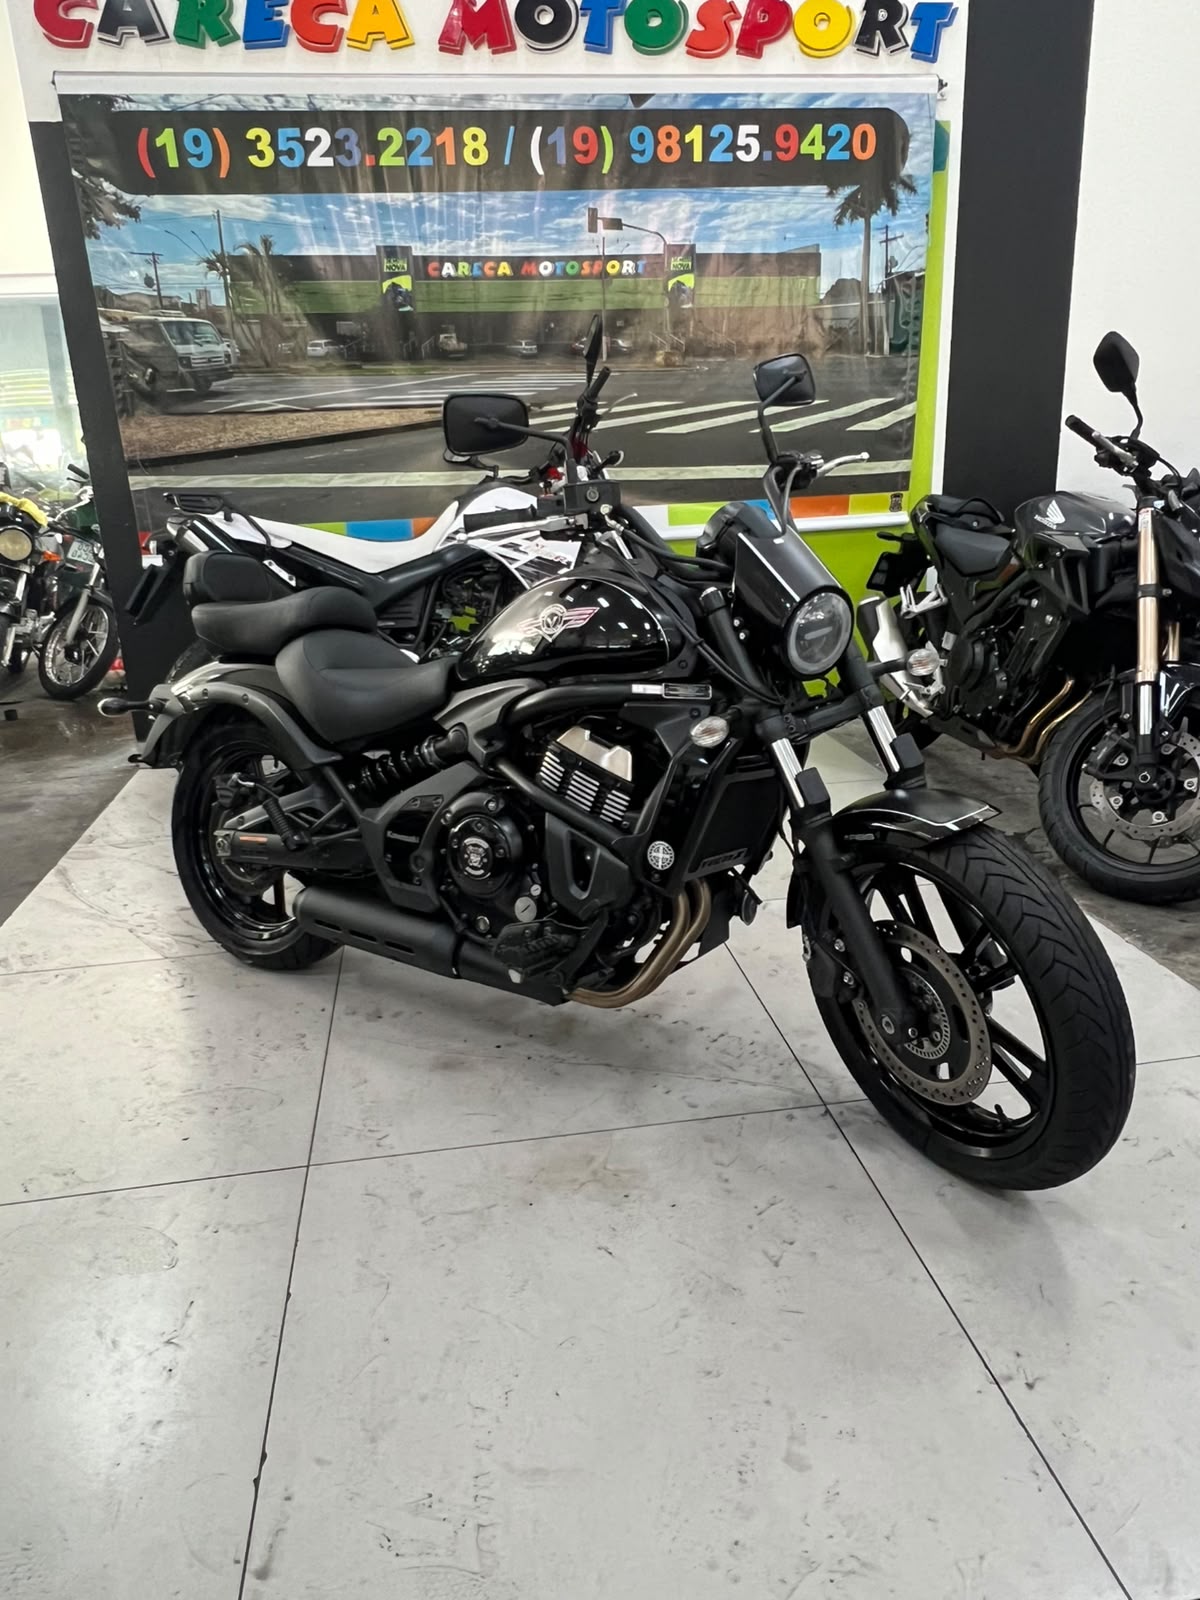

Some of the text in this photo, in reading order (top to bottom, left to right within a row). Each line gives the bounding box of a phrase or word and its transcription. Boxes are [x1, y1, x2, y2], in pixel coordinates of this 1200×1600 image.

[32, 0, 957, 63] CARECA MOTOSPORT
[137, 123, 877, 178] (19) 3523.2218 / (19) 98125.9420
[428, 260, 646, 278] CARECA MOTOSPORT
